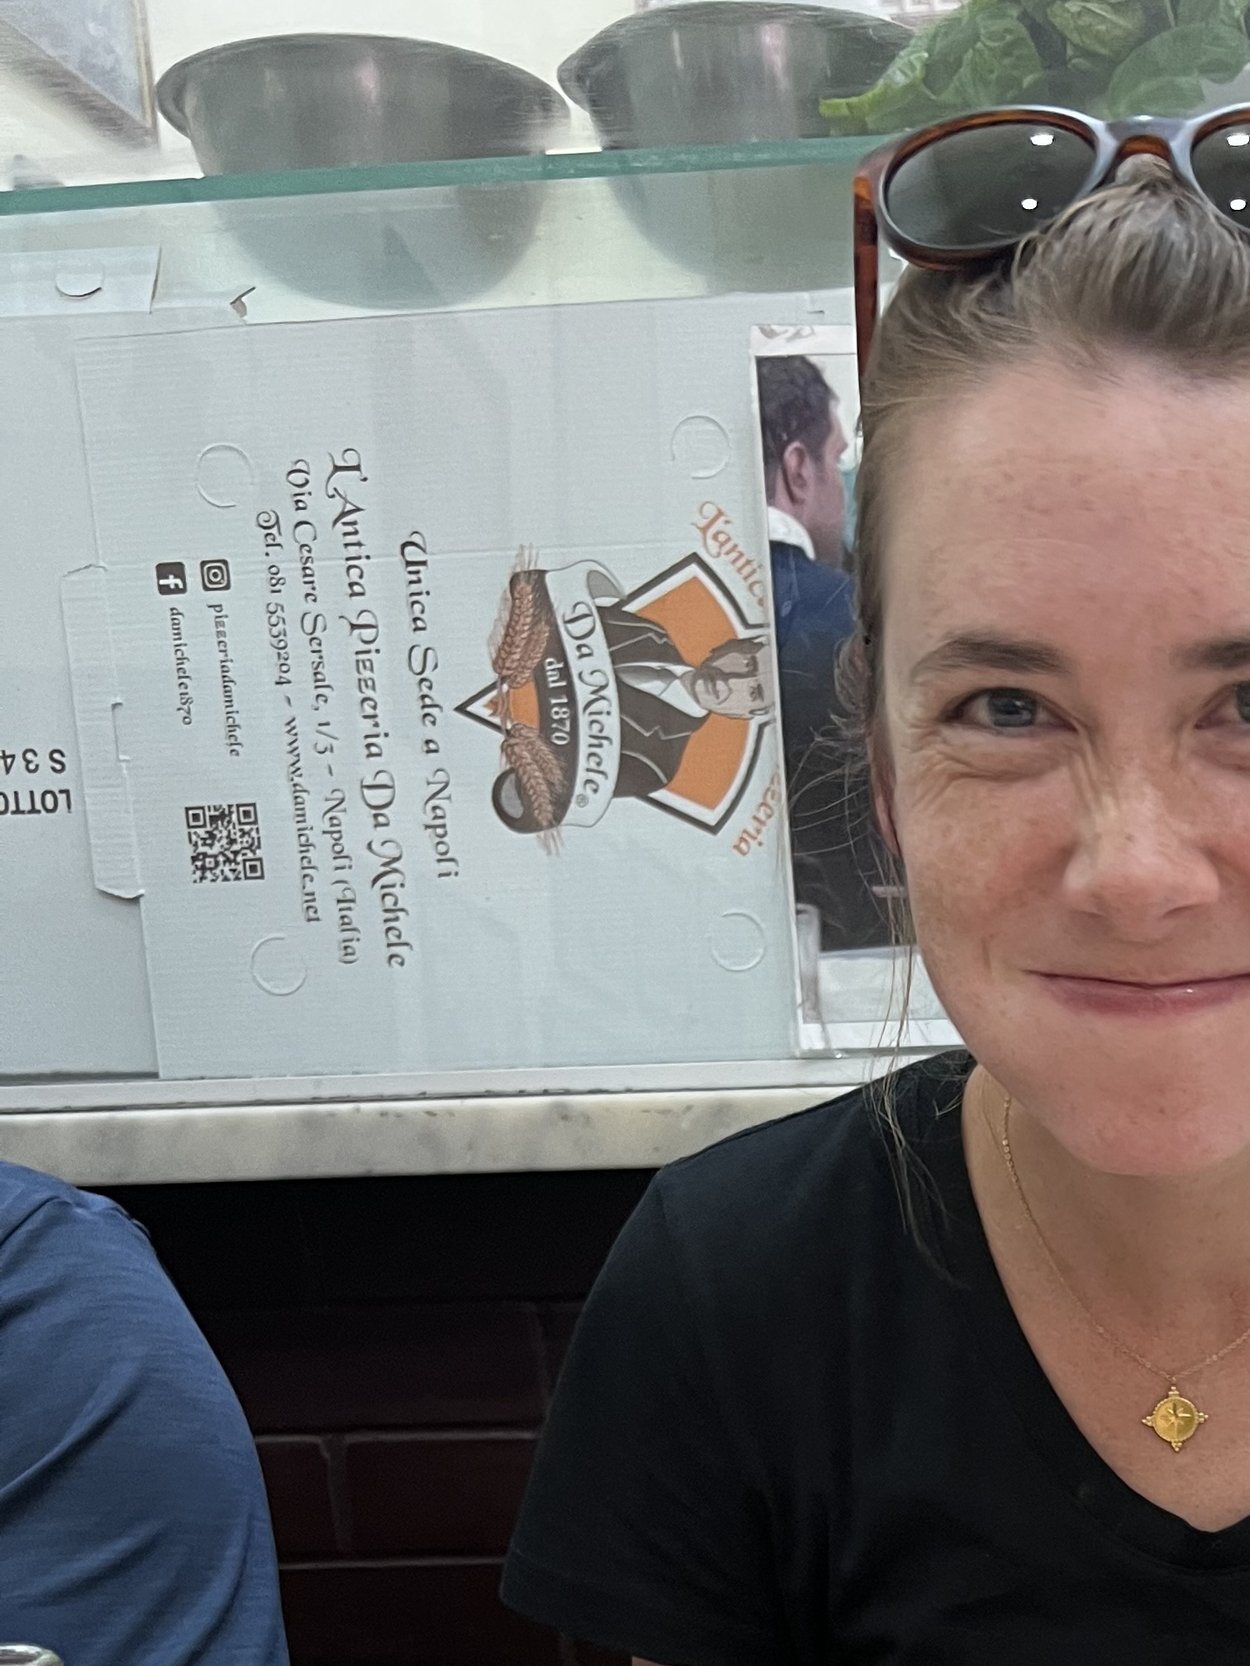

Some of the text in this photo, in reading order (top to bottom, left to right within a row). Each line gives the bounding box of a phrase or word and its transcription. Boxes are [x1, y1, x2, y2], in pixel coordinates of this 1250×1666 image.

[288, 460, 312, 512] Via
[256, 509, 282, 557] Tel.
[292, 520, 320, 603] Cesare
[268, 565, 287, 595] 081
[168, 607, 195, 725] damichele1870
[209, 603, 244, 757] pizzeriadamichele
[266, 602, 293, 686] 5539204
[301, 611, 333, 712] Sersale,
[325, 448, 413, 969] L'Antica Pizzeria Da Michele
[400, 530, 459, 879] Unica Sede a Napoli
[544, 658, 570, 745] dal 1870
[562, 602, 612, 794] Da Michele
[283, 717, 323, 923] www.damichele.net
[323, 789, 351, 871] Napoli
[332, 879, 358, 966] (Italia)
